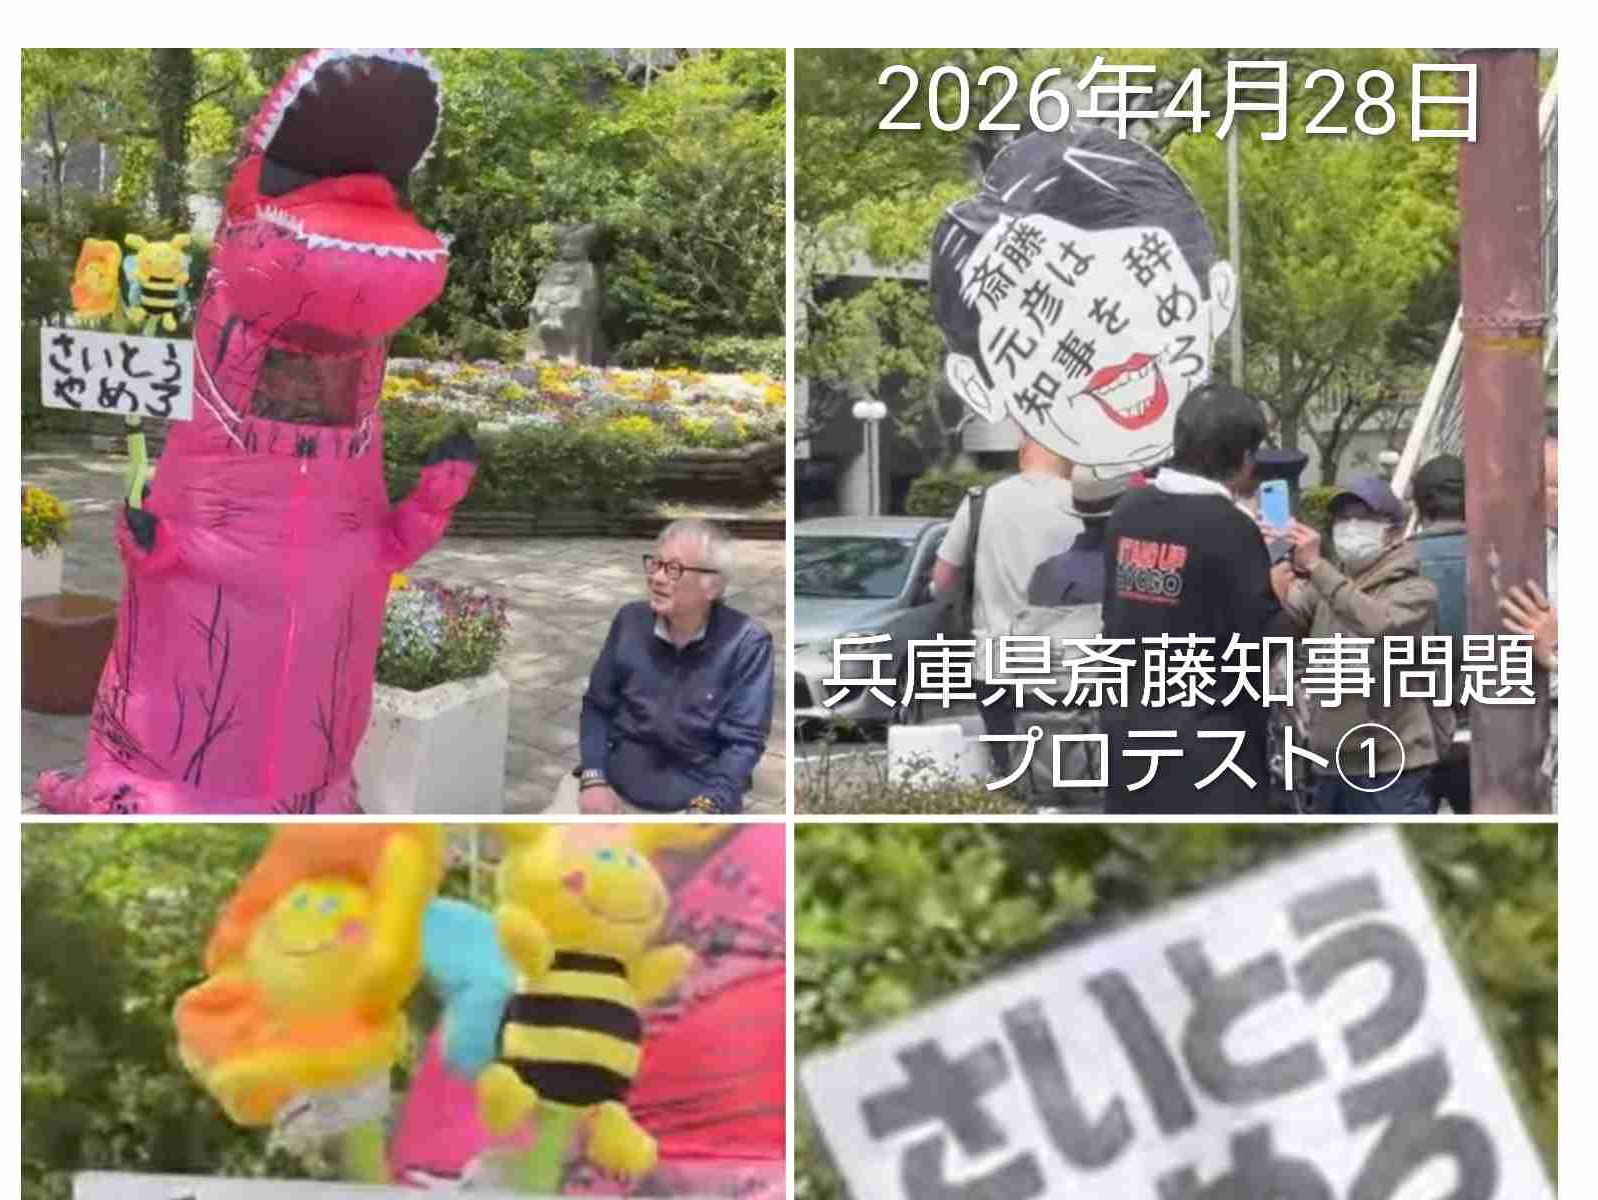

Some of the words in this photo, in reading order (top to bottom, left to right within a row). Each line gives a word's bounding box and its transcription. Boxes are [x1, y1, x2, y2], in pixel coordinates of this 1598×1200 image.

[49, 333, 182, 383] さいとう
[53, 374, 182, 417] やめろ
